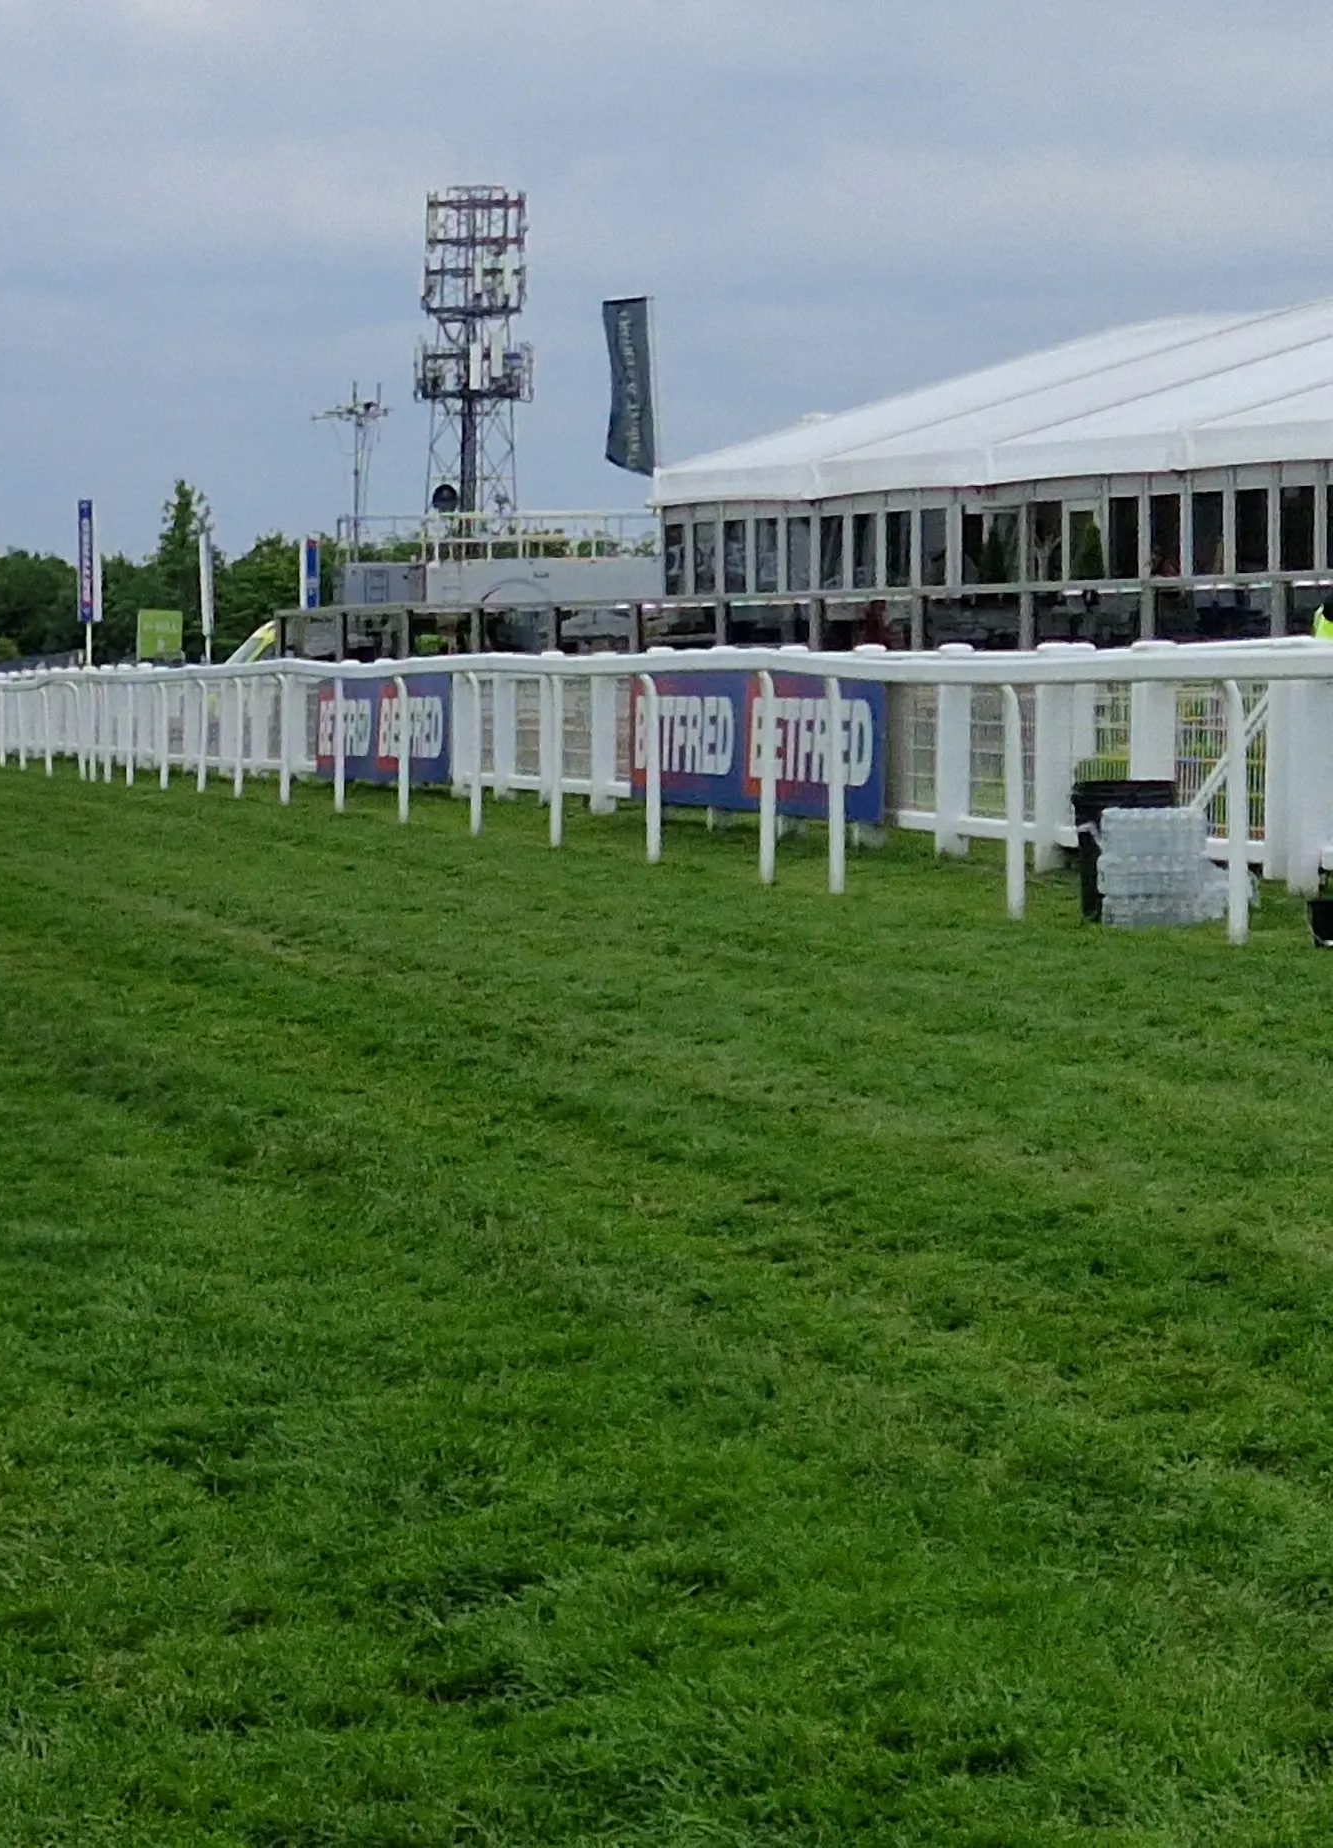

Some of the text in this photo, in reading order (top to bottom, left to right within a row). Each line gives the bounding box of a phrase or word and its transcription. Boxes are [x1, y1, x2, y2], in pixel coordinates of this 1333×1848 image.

[317, 698, 372, 757] BEFRED
[378, 695, 443, 759] BEFRED
[634, 696, 734, 776] BTFRED
